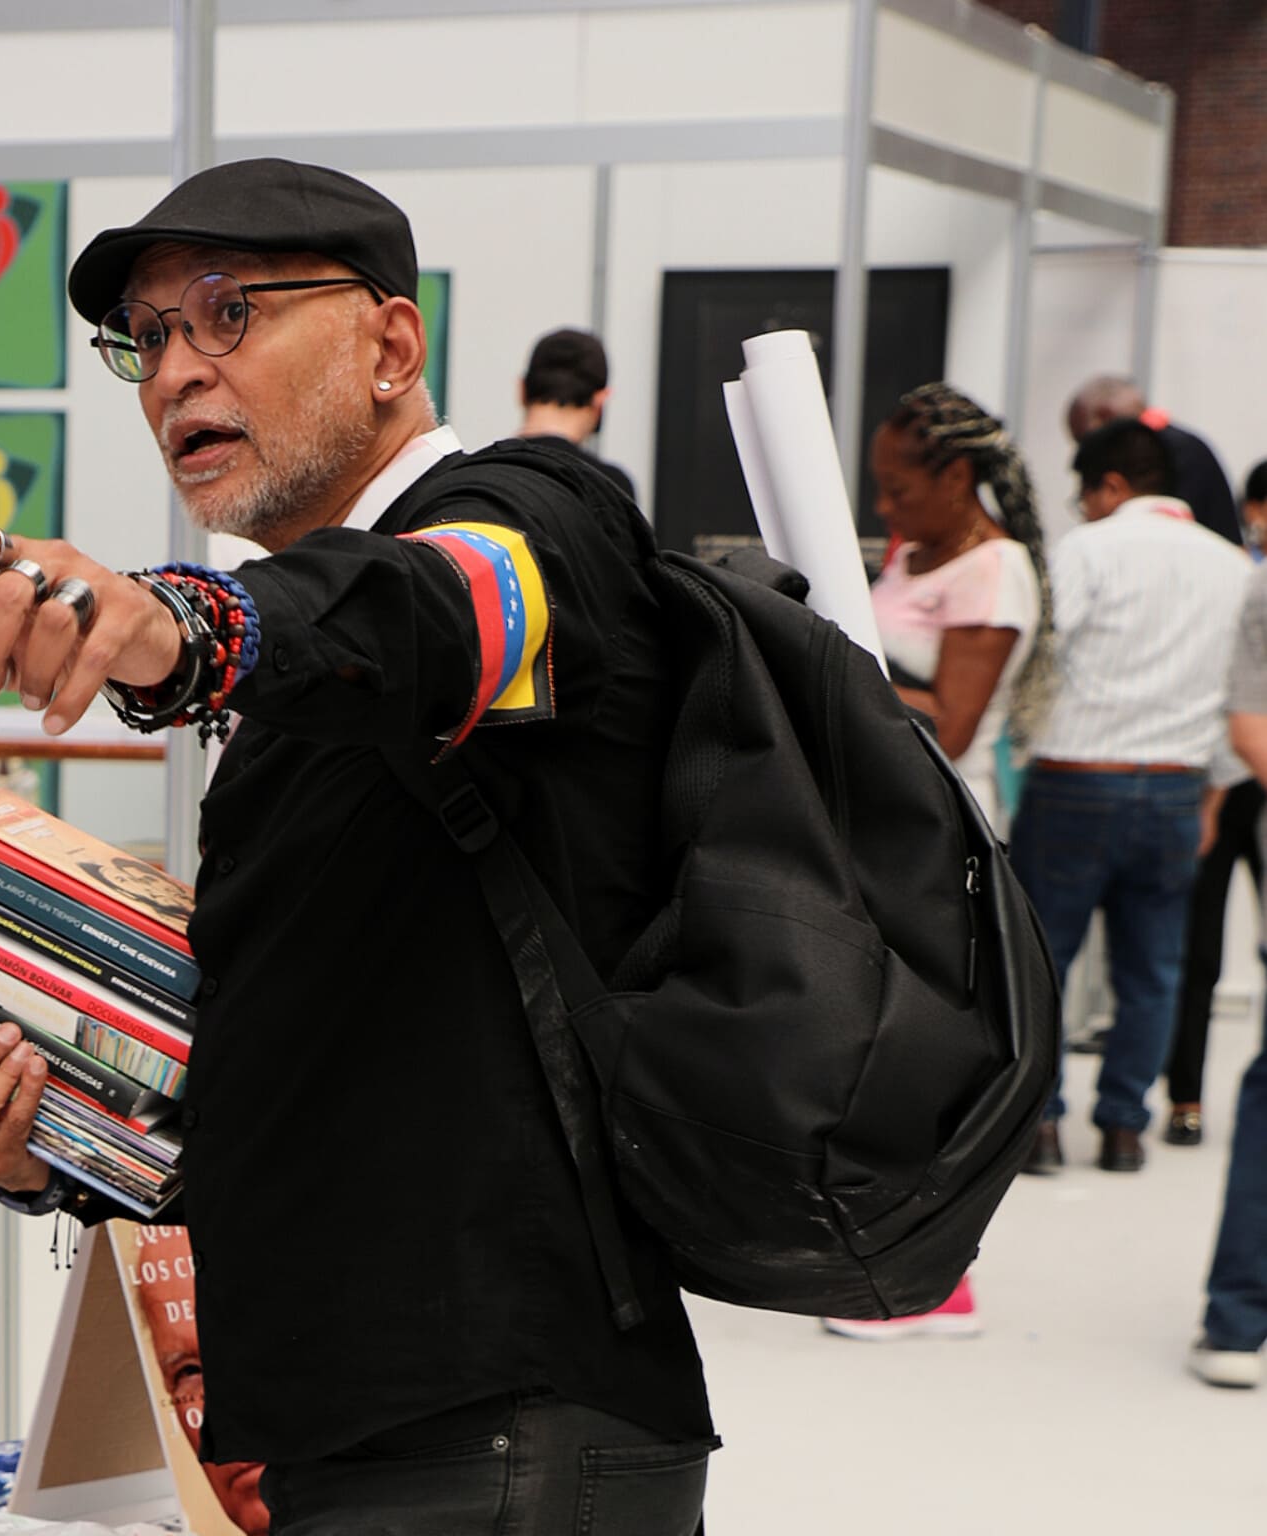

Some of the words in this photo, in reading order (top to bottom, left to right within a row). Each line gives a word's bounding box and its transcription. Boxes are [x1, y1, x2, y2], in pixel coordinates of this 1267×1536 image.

[25, 894, 39, 905] DE
[38, 901, 52, 912] UN
[52, 907, 82, 928] TIEMPO
[81, 923, 120, 948] ERNESTO
[119, 944, 138, 957] CHE
[137, 953, 177, 978] GUEVARA
[29, 972, 74, 1000] BOLÍVAR
[87, 1001, 155, 1043] DOCUMENTOS
[111, 976, 142, 996] ERNESTO
[155, 999, 187, 1020] GUEVARA
[60, 1061, 104, 1091] ESCOGIDAS
[129, 1259, 170, 1285] LOS
[164, 1299, 195, 1324] DE
